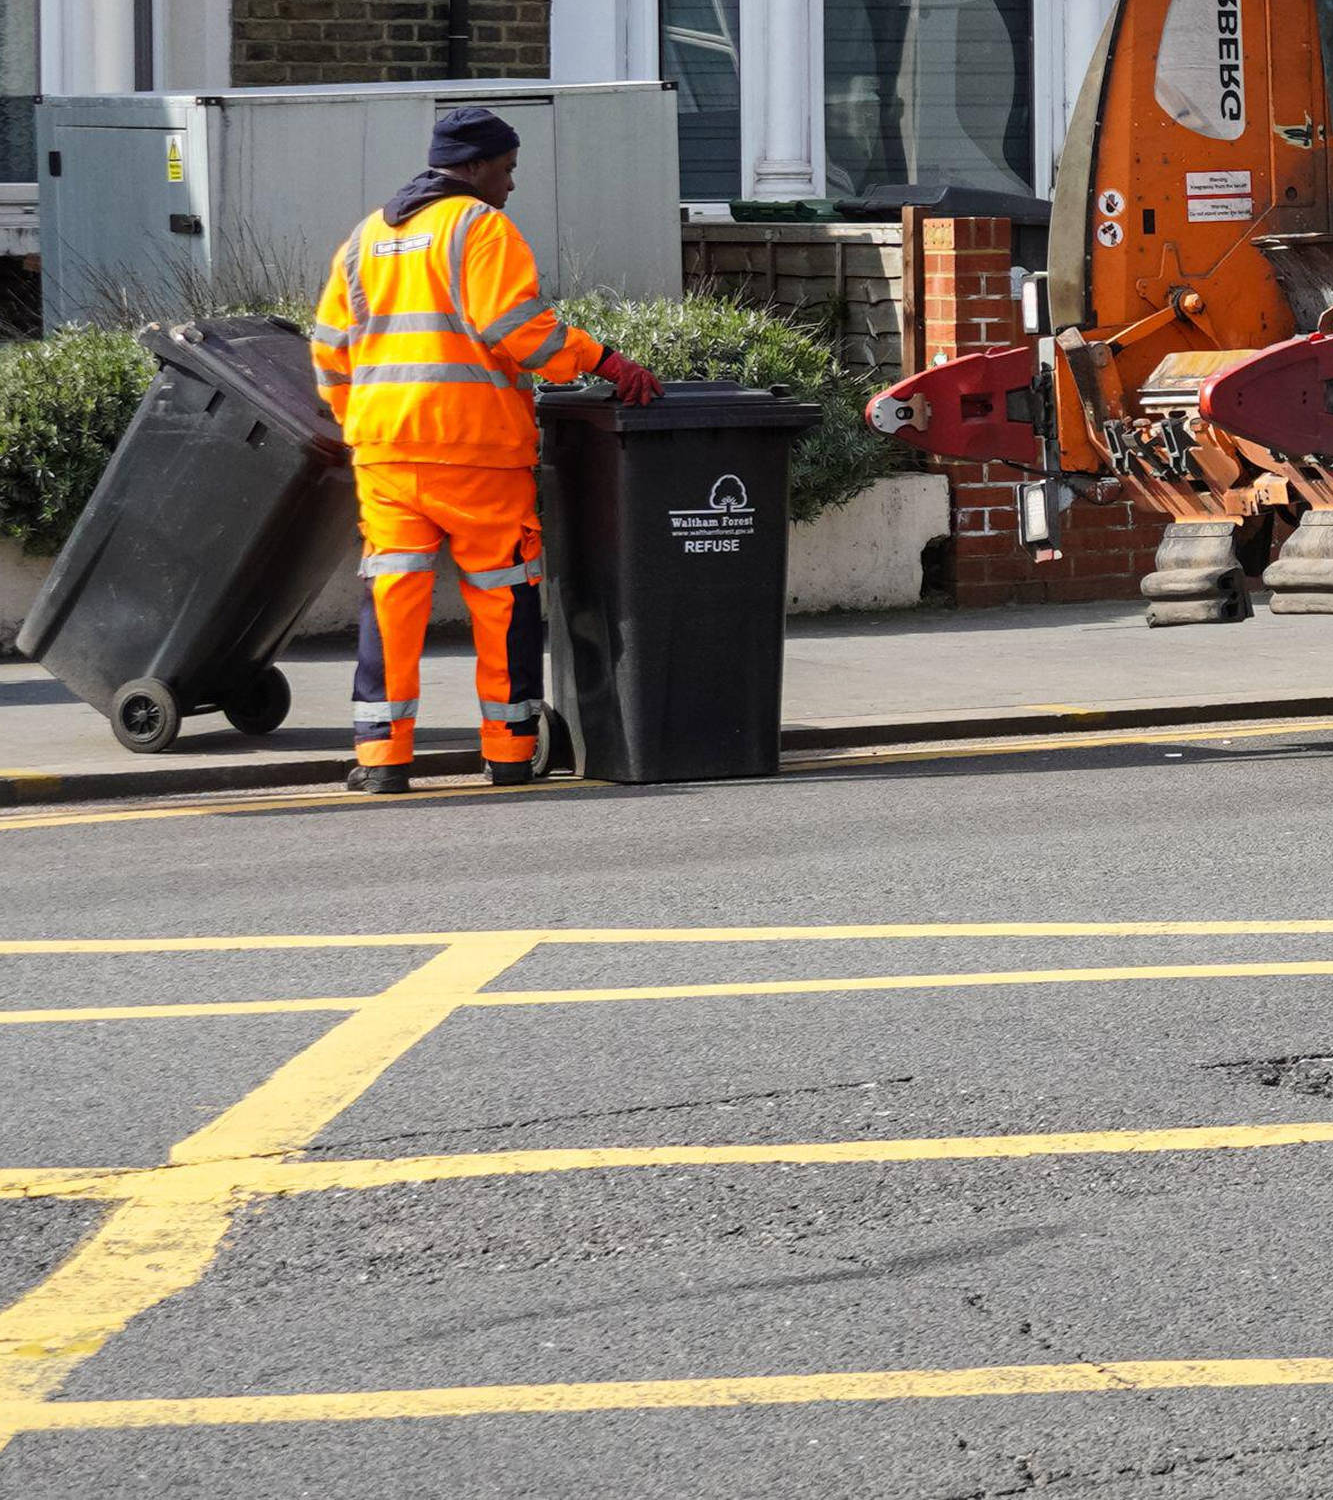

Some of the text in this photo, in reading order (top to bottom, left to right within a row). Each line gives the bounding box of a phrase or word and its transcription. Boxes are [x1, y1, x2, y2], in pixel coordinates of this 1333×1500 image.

[671, 516, 753, 528] Waltham Forest
[684, 539, 740, 553] REFUSE
